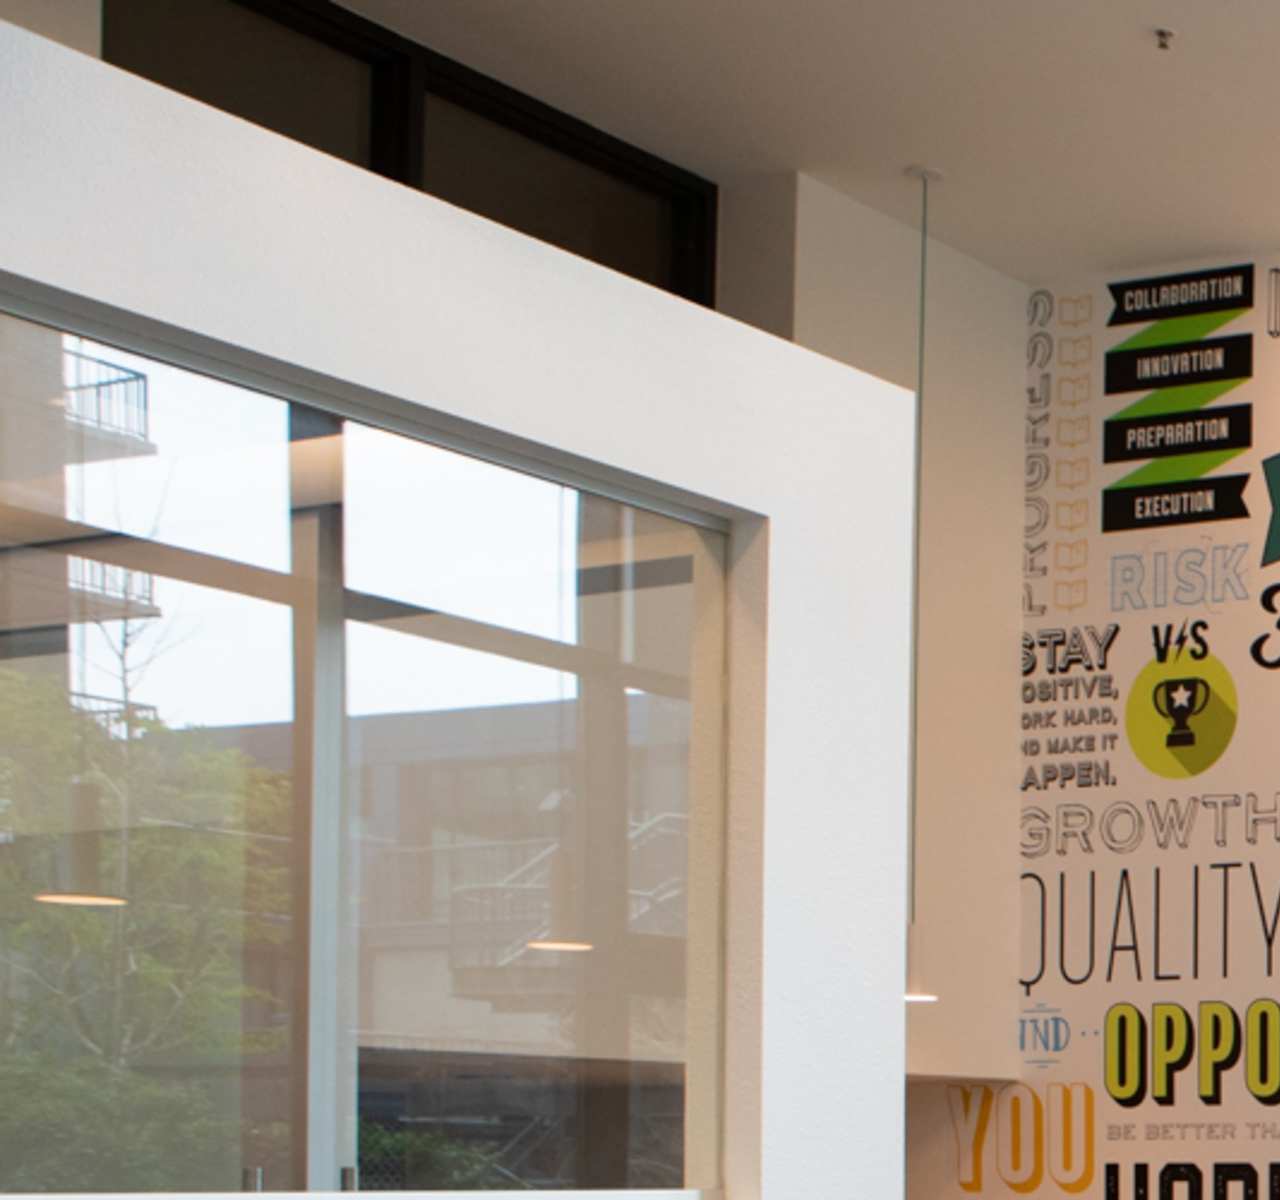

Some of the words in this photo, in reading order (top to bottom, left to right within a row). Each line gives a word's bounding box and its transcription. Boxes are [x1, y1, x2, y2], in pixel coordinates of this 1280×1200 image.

[1124, 276, 1244, 312] COLLABORATION
[1136, 349, 1225, 380] INNOVATION
[1126, 418, 1230, 450] PREPARATION
[1134, 490, 1215, 520] EXECUTION
[1110, 543, 1249, 613] RISK
[1021, 623, 1121, 677] STAY
[1021, 674, 1120, 704] OSITIVE,
[1021, 711, 1057, 730] ORK
[1047, 734, 1096, 755] MAKE
[1101, 733, 1119, 751] IT
[1021, 760, 1118, 791] APPEN.
[947, 1082, 1095, 1195] YOU
[1106, 1123, 1137, 1143] BE
[1144, 1122, 1236, 1143] BETTER
